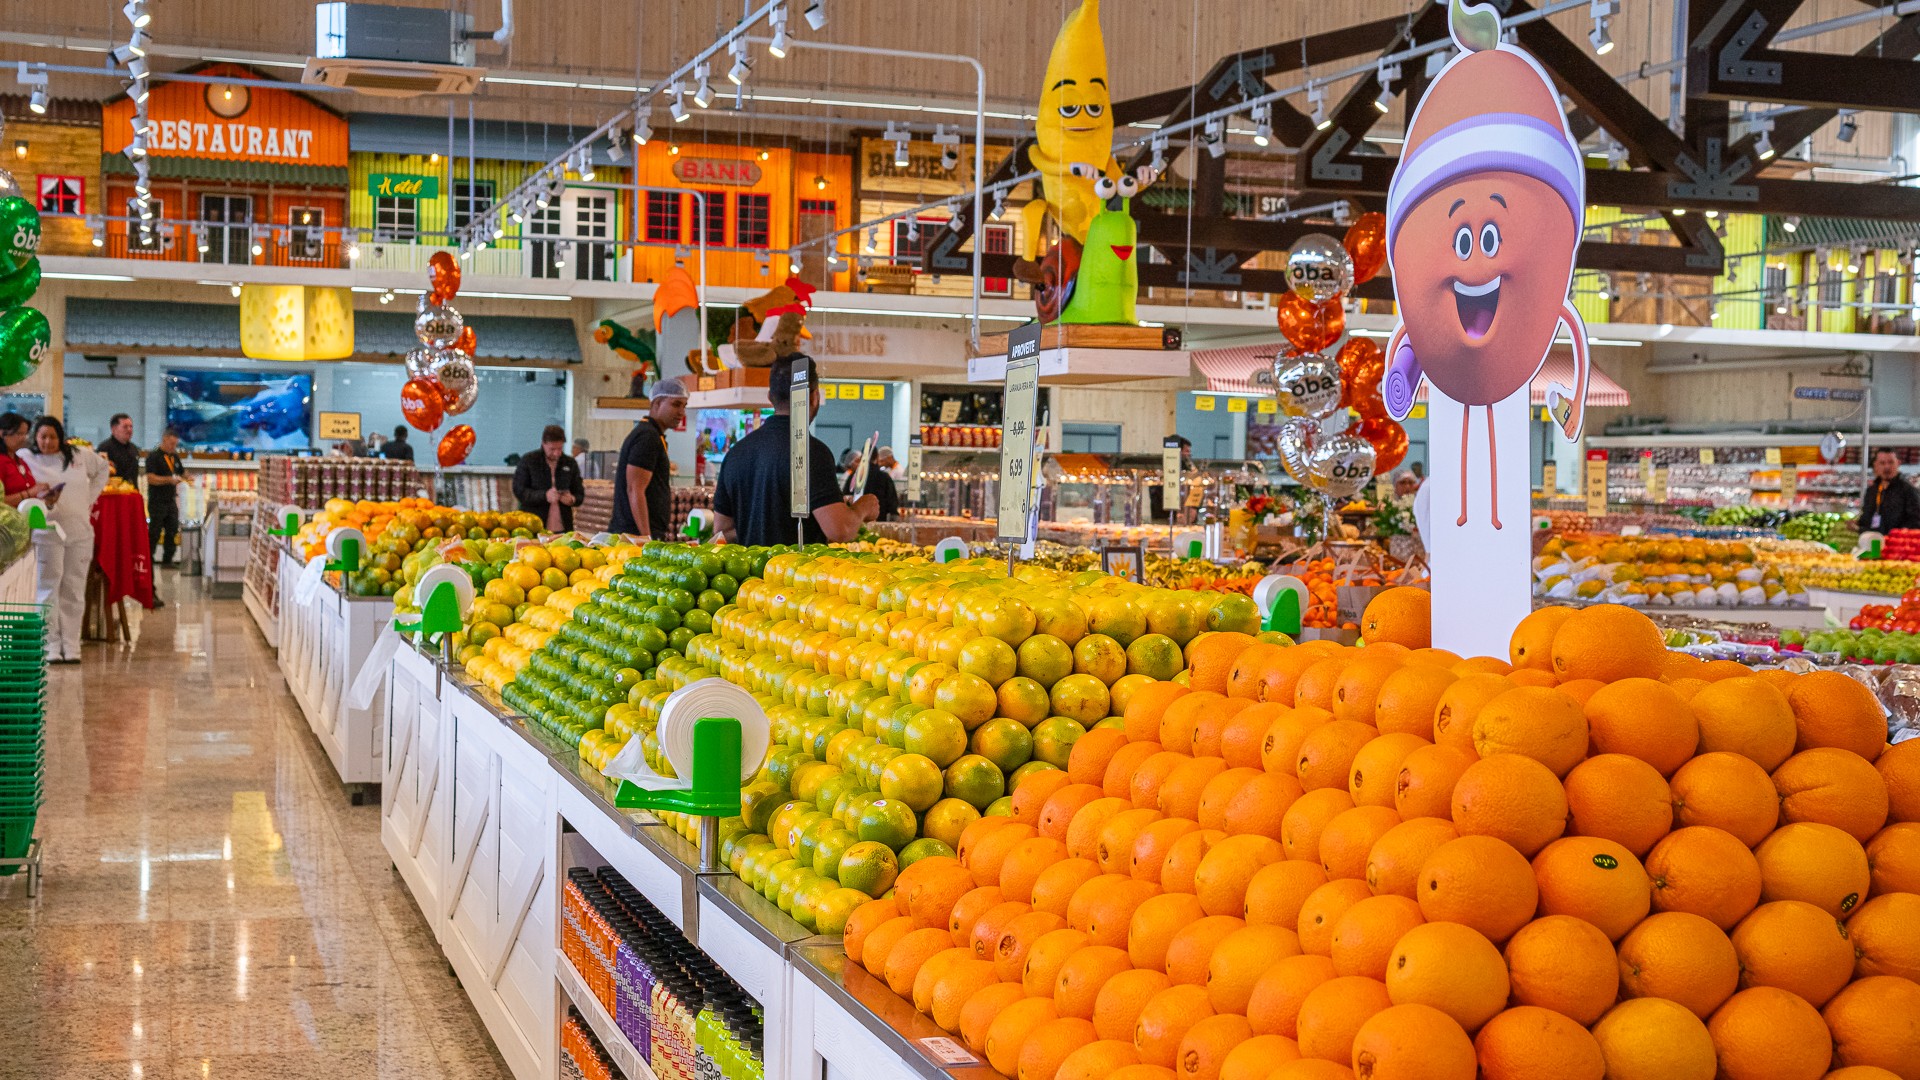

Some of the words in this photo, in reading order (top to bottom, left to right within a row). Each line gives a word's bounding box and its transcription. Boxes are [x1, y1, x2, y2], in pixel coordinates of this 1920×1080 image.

[147, 119, 313, 158] RESTAURANT
[683, 160, 751, 180] BANK
[1011, 340, 1036, 358] APROVEITE
[1009, 458, 1023, 479] 6,99
[1594, 856, 1617, 867] MAFA
